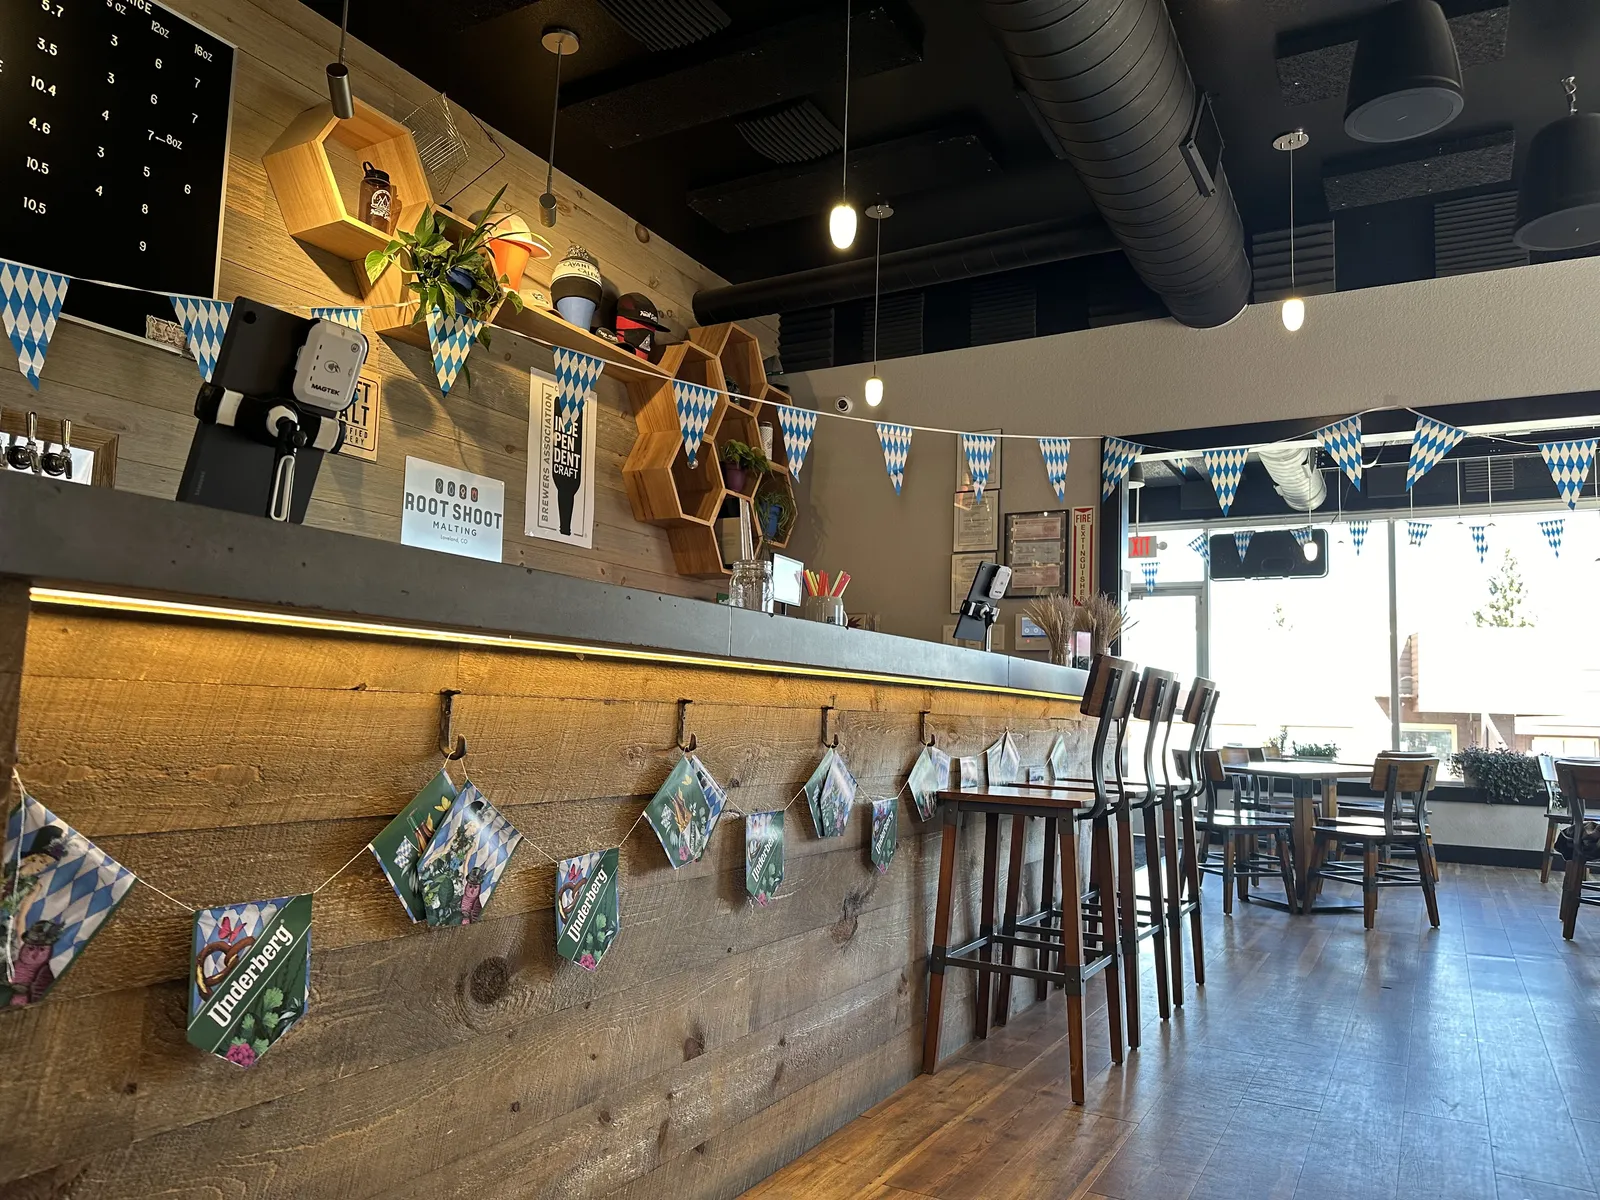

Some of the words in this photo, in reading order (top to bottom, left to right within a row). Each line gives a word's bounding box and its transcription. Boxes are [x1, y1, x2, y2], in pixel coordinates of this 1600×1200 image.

[42, 0, 64, 18] 5.7
[111, 34, 119, 47] 3
[154, 58, 163, 70] 6
[194, 77, 201, 88] 7
[37, 36, 58, 56] 3.5
[107, 71, 115, 84] 3
[150, 93, 158, 105] 6
[191, 112, 199, 124] 7
[30, 75, 57, 97] 10.4
[101, 109, 110, 121] 4
[147, 129, 155, 141] 7
[28, 117, 51, 135] 4.6
[97, 145, 105, 158] 3
[142, 165, 151, 178] 5
[184, 183, 192, 195] 6
[26, 156, 50, 175] 10.5
[95, 185, 103, 197] 4
[141, 203, 149, 215] 8
[23, 196, 47, 215] 10.5
[139, 240, 147, 251] 9
[310, 383, 341, 397] MAGTEK
[338, 402, 370, 427] ALT
[542, 392, 553, 465] ASSOCIATION
[554, 431, 575, 452] PEN
[553, 447, 581, 469] DENT
[553, 463, 578, 480] CRAFT
[405, 492, 449, 518] ROOT
[452, 503, 502, 530] SHOOT
[541, 467, 551, 522] BREWERS
[1075, 513, 1092, 524] FIRE
[432, 521, 477, 537] MALTING
[1129, 536, 1151, 557] XIT
[751, 828, 779, 883] Underberg
[566, 868, 608, 943] Underberg
[207, 924, 294, 1028] Underberg
